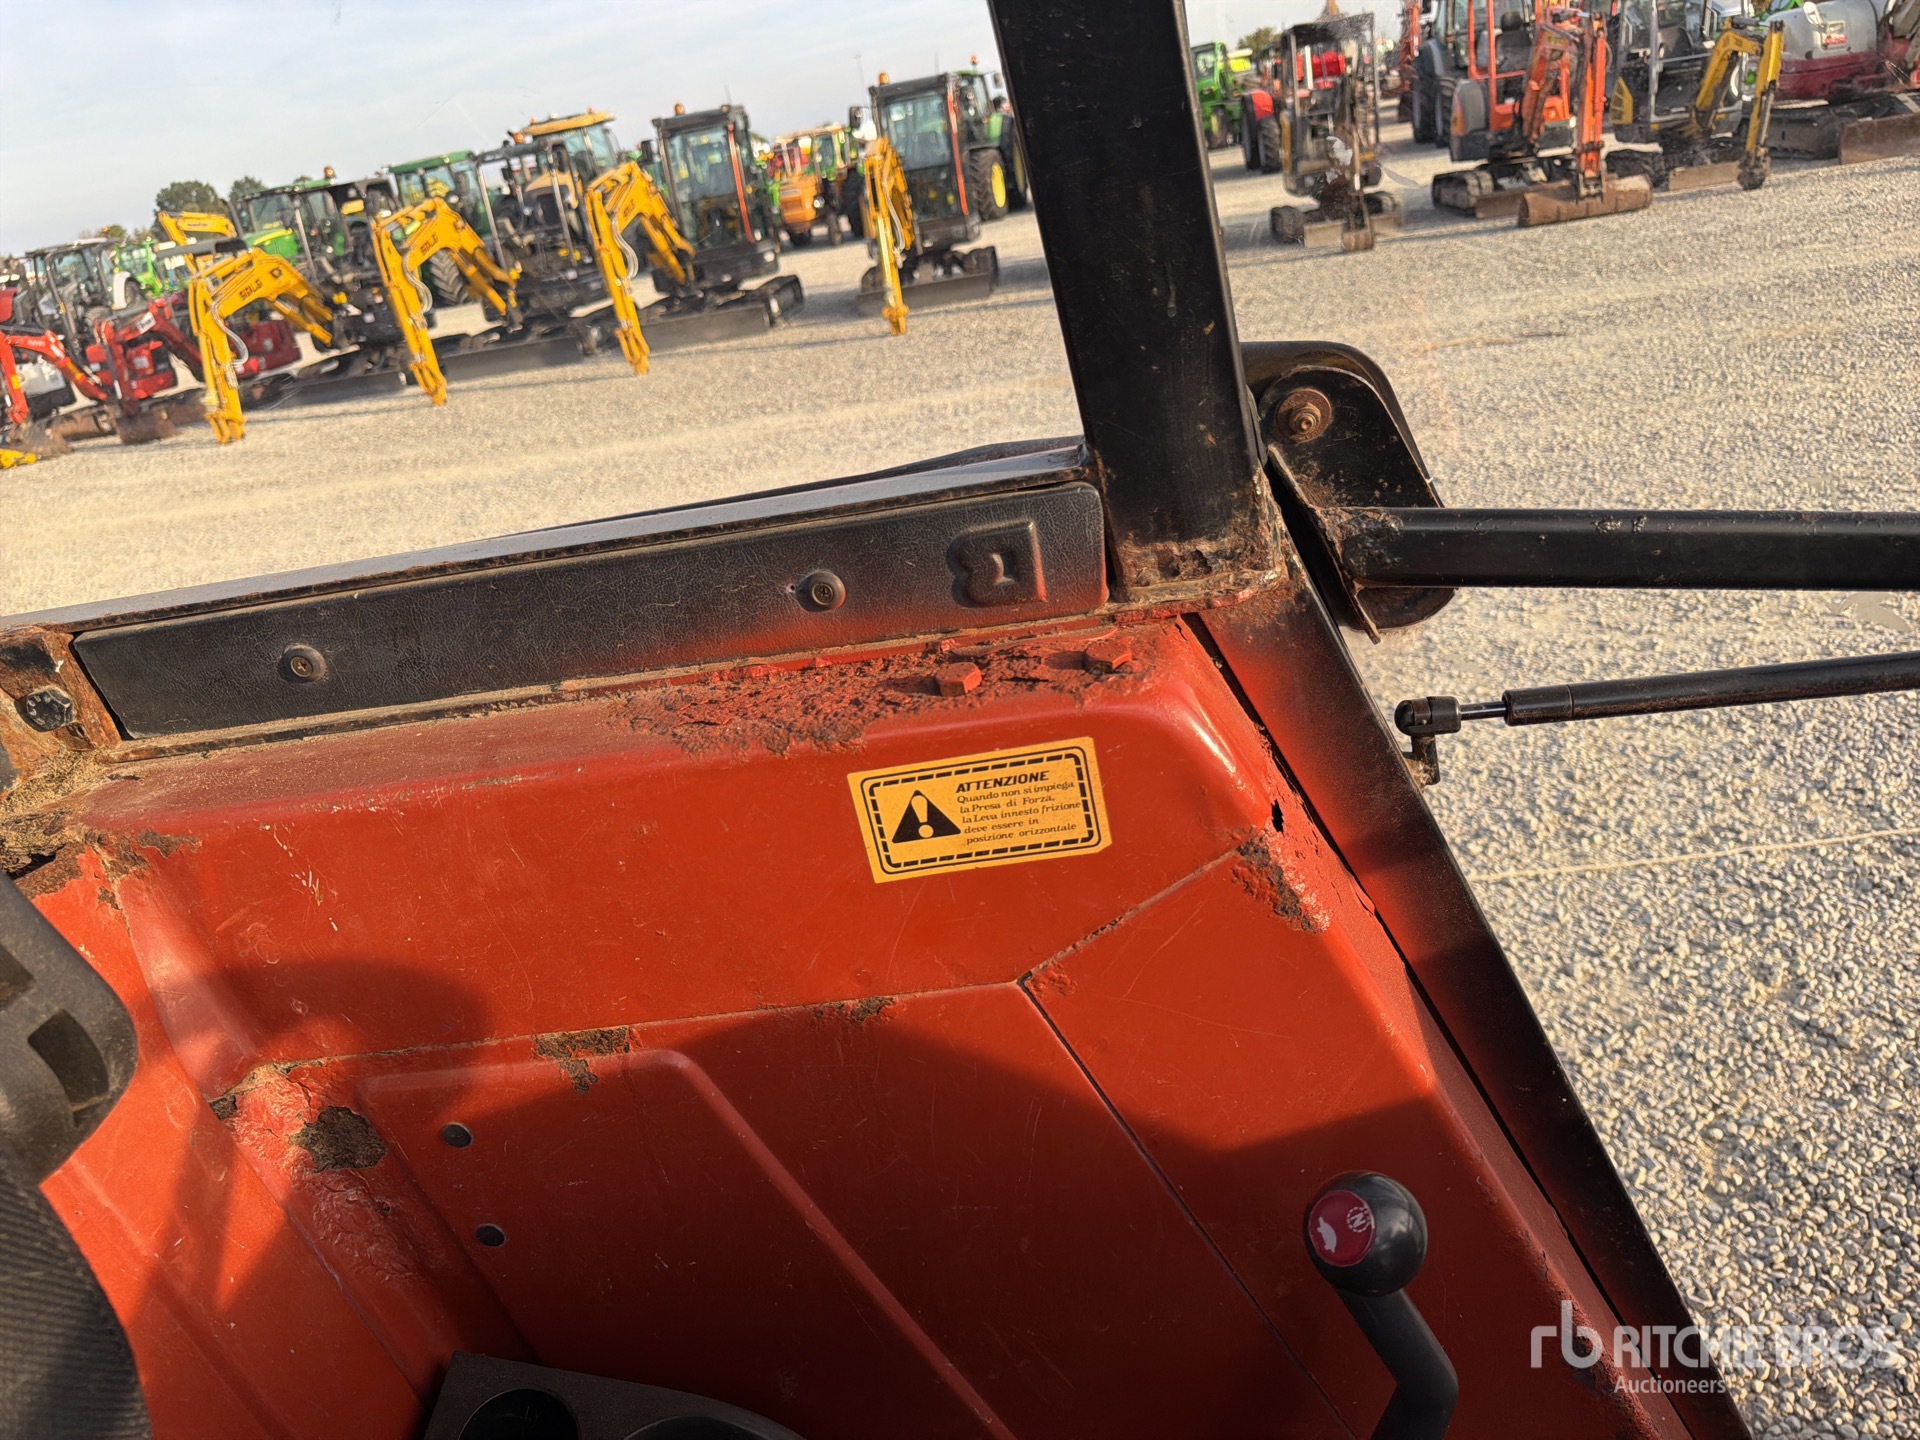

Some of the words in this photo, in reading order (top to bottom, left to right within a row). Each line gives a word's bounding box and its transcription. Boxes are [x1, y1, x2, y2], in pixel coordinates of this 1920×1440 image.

[956, 770, 1050, 794] ATTENZIONE
[957, 791, 999, 804] Quando
[1001, 789, 1021, 797] non
[1023, 785, 1032, 794] si
[1033, 781, 1075, 793] impiega
[960, 806, 970, 814] la
[972, 802, 1001, 812] Presa
[1006, 798, 1017, 807] di
[973, 813, 998, 822] Leva
[1001, 807, 1040, 819] innesto
[1041, 802, 1081, 815] frizione
[964, 825, 988, 834] deve
[991, 820, 1024, 830] essere
[1028, 817, 1040, 825] in
[966, 832, 1014, 846] posizione
[1018, 822, 1077, 837] orizzontale
